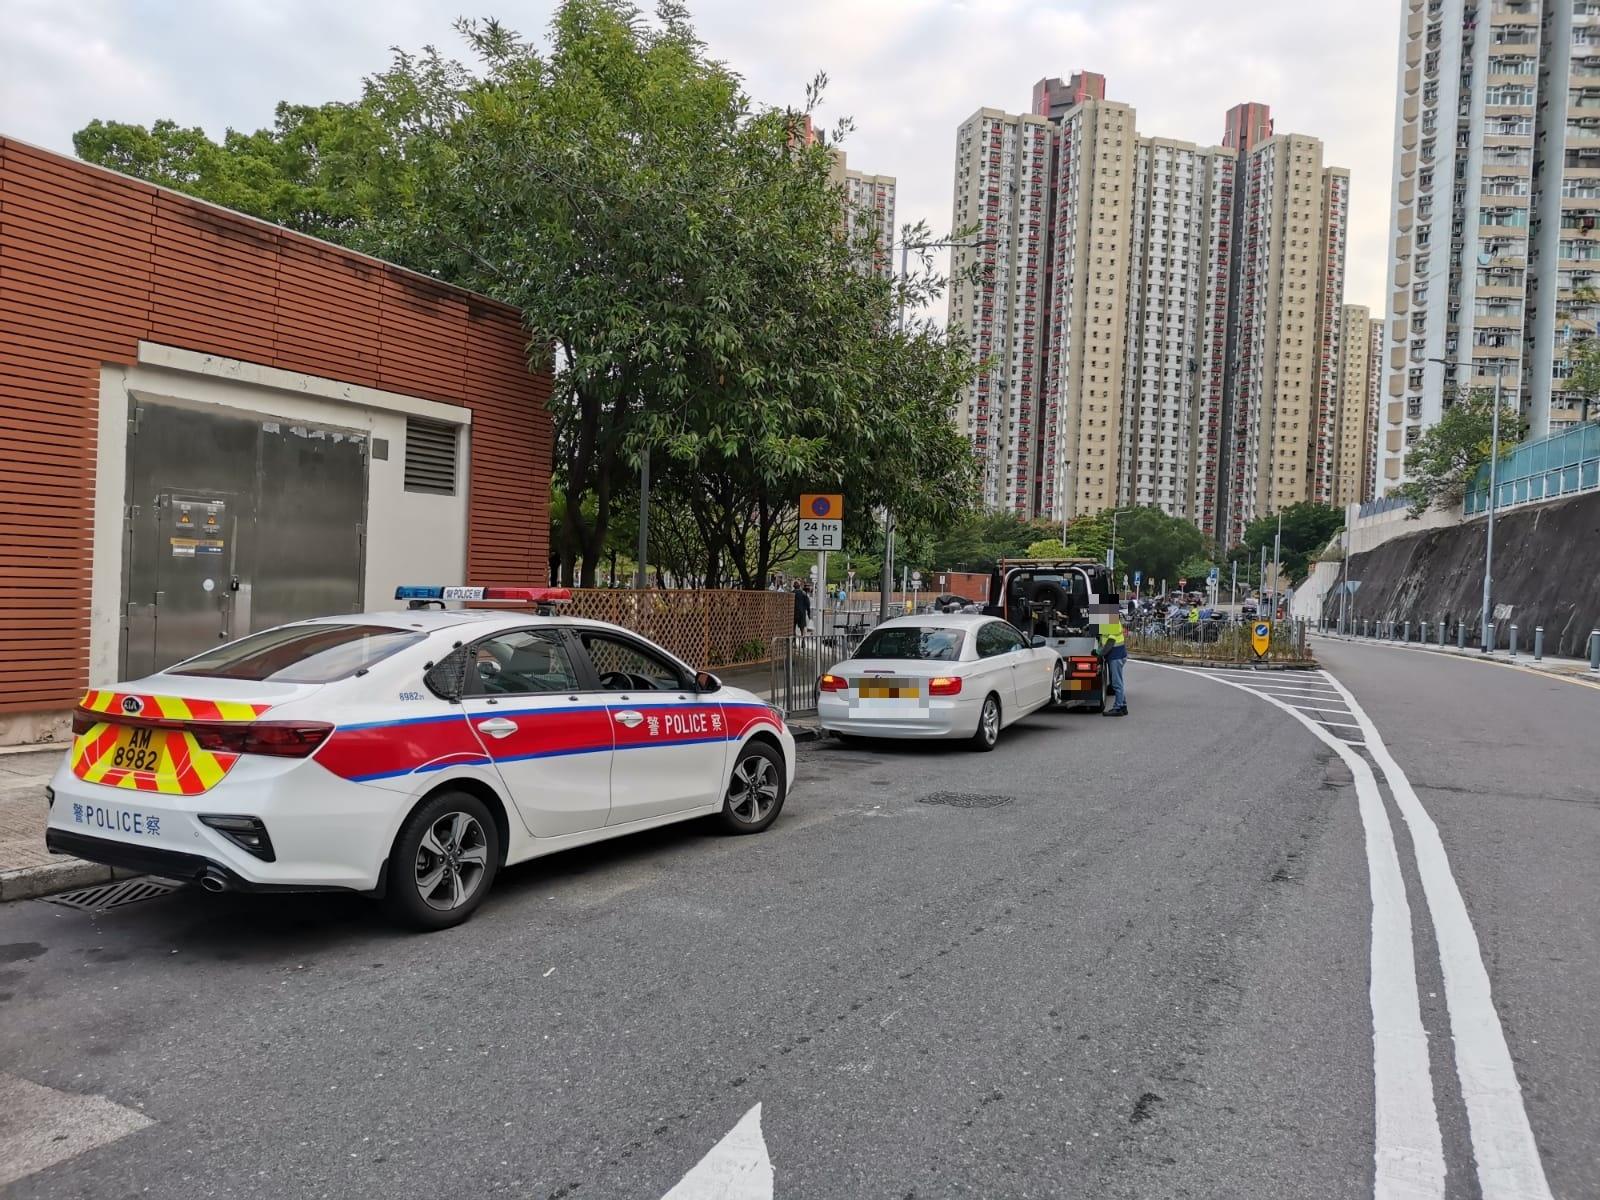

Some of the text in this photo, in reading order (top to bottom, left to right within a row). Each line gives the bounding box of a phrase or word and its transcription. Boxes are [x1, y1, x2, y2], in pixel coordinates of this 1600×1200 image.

[803, 522, 838, 531] 24 hrs
[807, 534, 832, 546] 全日
[454, 589, 473, 599] POLICE
[647, 713, 722, 736] 警 POLICE 察
[128, 729, 152, 749] AM
[114, 747, 157, 771] 8982
[73, 803, 160, 835] 警 POLICE 察
